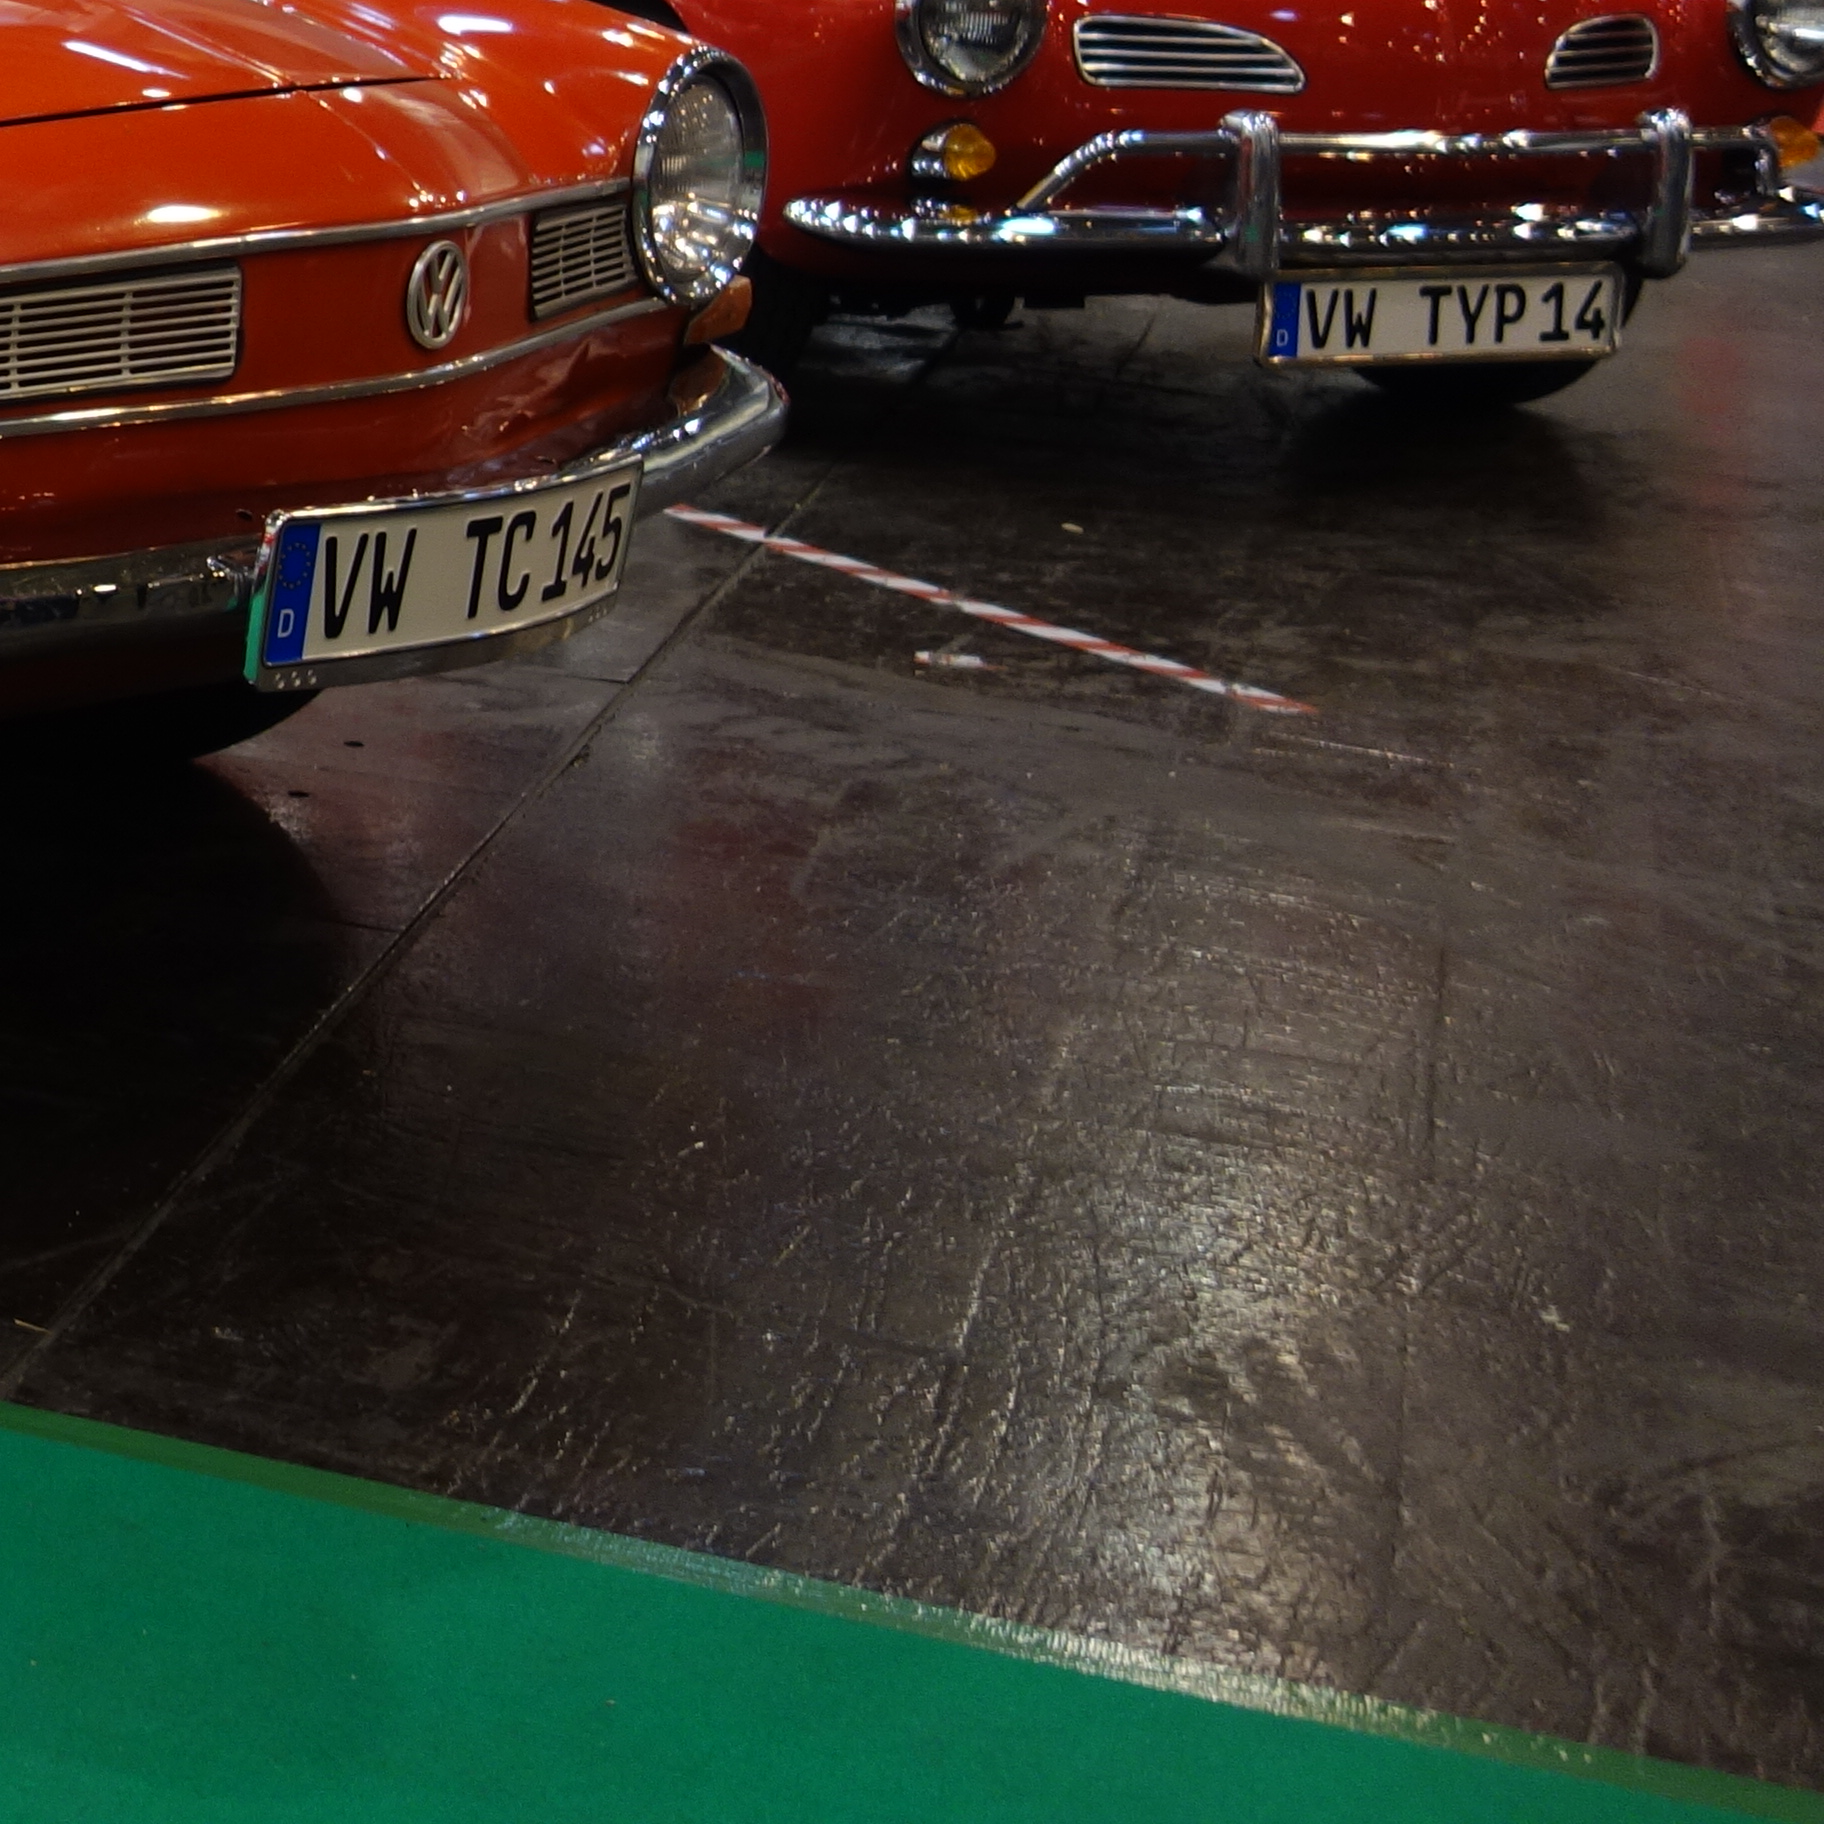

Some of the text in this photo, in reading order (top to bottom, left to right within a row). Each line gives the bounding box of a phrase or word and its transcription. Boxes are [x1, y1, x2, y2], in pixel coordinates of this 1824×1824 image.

[1277, 329, 1289, 347] D
[1306, 286, 1377, 350] VW
[276, 607, 296, 639] D
[323, 527, 418, 640] VW
